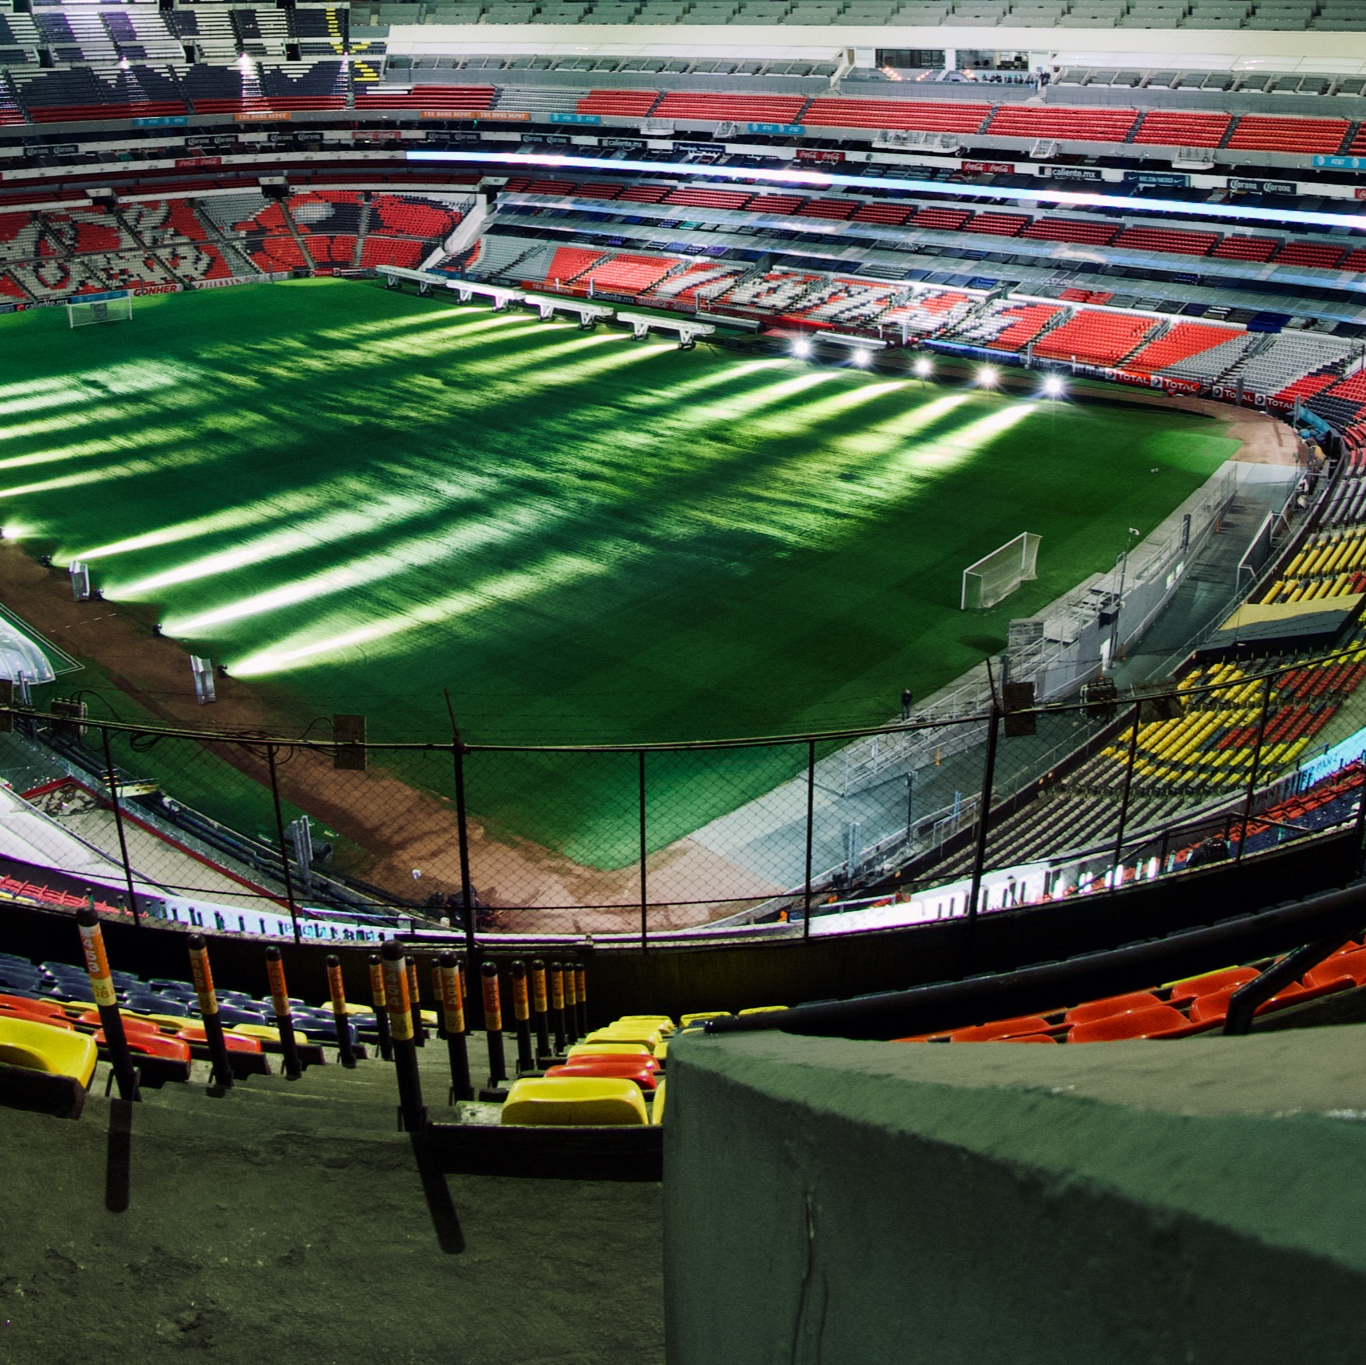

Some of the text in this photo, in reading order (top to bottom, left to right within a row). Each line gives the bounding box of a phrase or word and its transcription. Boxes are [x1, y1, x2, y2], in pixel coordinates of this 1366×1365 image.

[1052, 168, 1096, 178] caliente.mx
[1230, 180, 1291, 193] Corona Corona
[133, 285, 177, 296] GONHER
[1117, 373, 1196, 392] TOTAL TOTAL
[1224, 389, 1253, 402] TOAL
